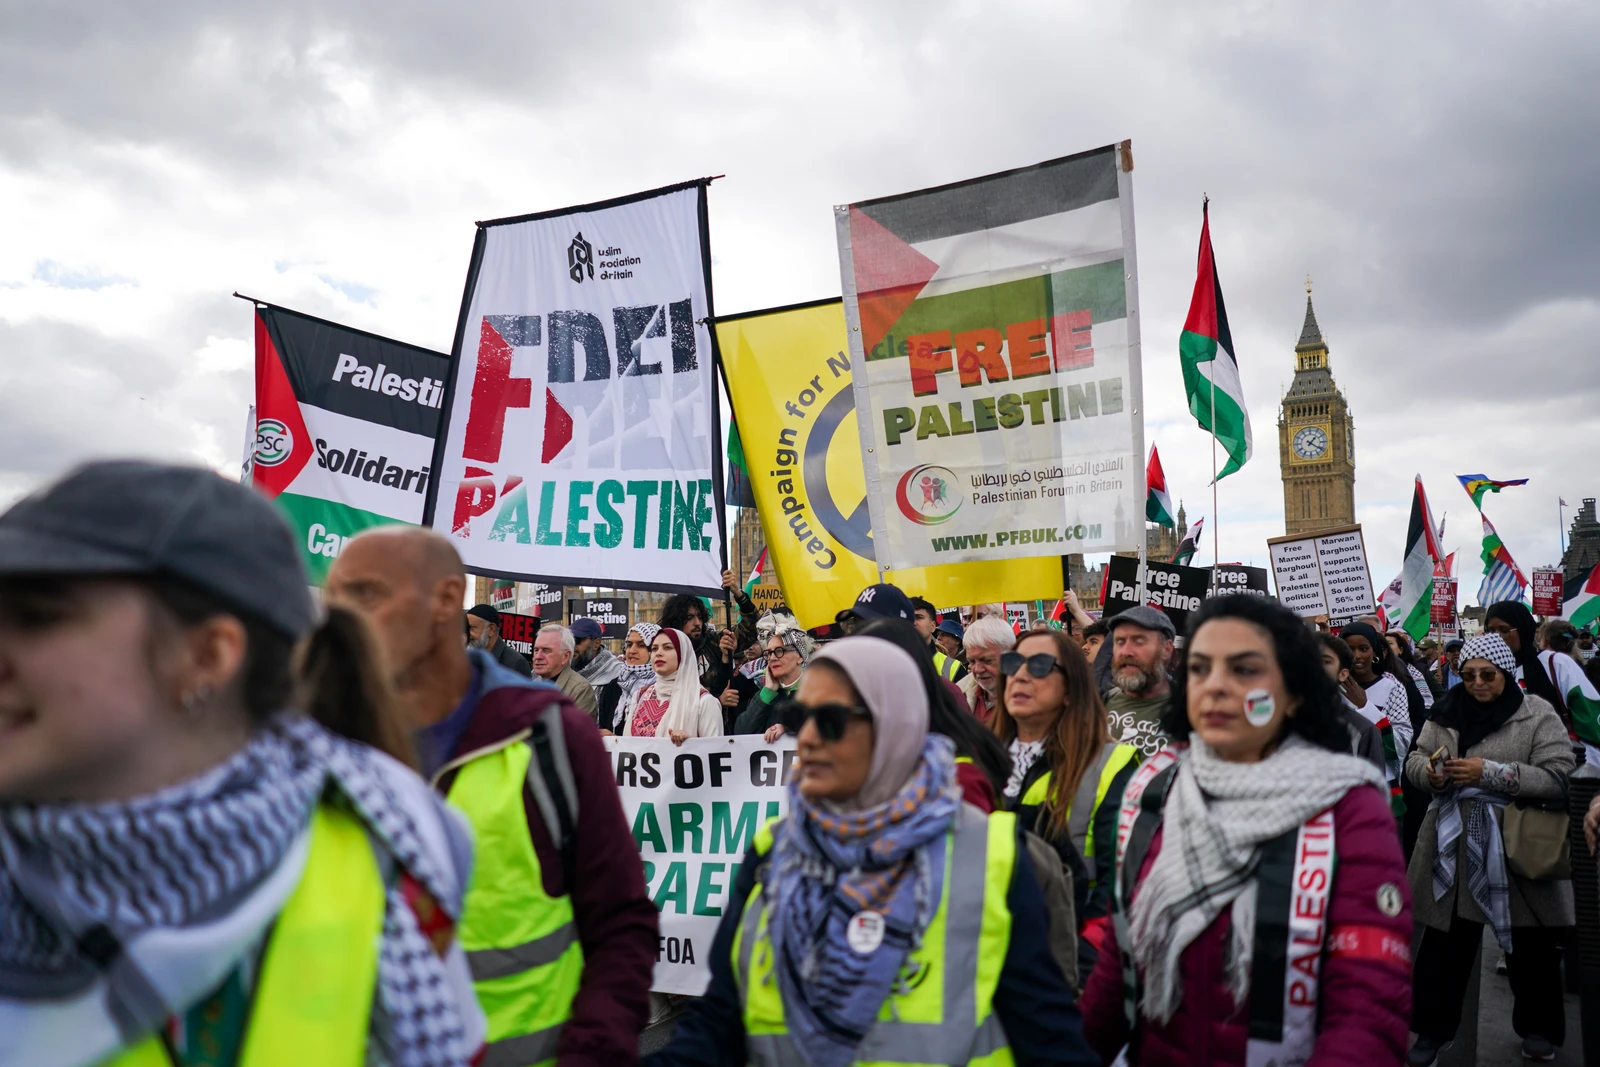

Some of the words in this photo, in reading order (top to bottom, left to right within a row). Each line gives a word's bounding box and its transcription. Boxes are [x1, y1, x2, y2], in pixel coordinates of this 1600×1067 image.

[906, 310, 1094, 397] FREE
[785, 374, 824, 419] for
[883, 377, 1124, 446] PALESTINE
[257, 434, 284, 452] PSC
[315, 438, 431, 494] Solidari
[1010, 470, 1031, 486] في
[972, 490, 1037, 504] Palestinian
[1041, 486, 1074, 498] Forum
[1076, 482, 1086, 494] in
[1090, 478, 1122, 492] Britain
[770, 428, 836, 570] Campaign
[451, 466, 713, 552] PALESTINE
[931, 524, 1102, 552] WWW.PFBUK.COM
[1322, 536, 1354, 546] Marwan
[1320, 544, 1360, 556] Barghouti
[1278, 554, 1312, 563] Marwan
[1324, 556, 1360, 566] supports
[1276, 562, 1316, 573] Barghouti
[1324, 565, 1364, 576] two-state
[1281, 582, 1320, 592] Palestine
[1328, 575, 1364, 585] solution.
[1206, 585, 1266, 600] alestine
[1285, 592, 1319, 602] political
[587, 601, 613, 613] Free
[1290, 602, 1324, 612] risoners
[1332, 604, 1372, 614] Palestine
[575, 613, 626, 624] stine
[503, 639, 533, 654] ESTINE
[615, 752, 660, 788] RS
[674, 752, 732, 789] OF
[644, 861, 744, 917] AE
[1289, 806, 1332, 1008] PALESTIN
